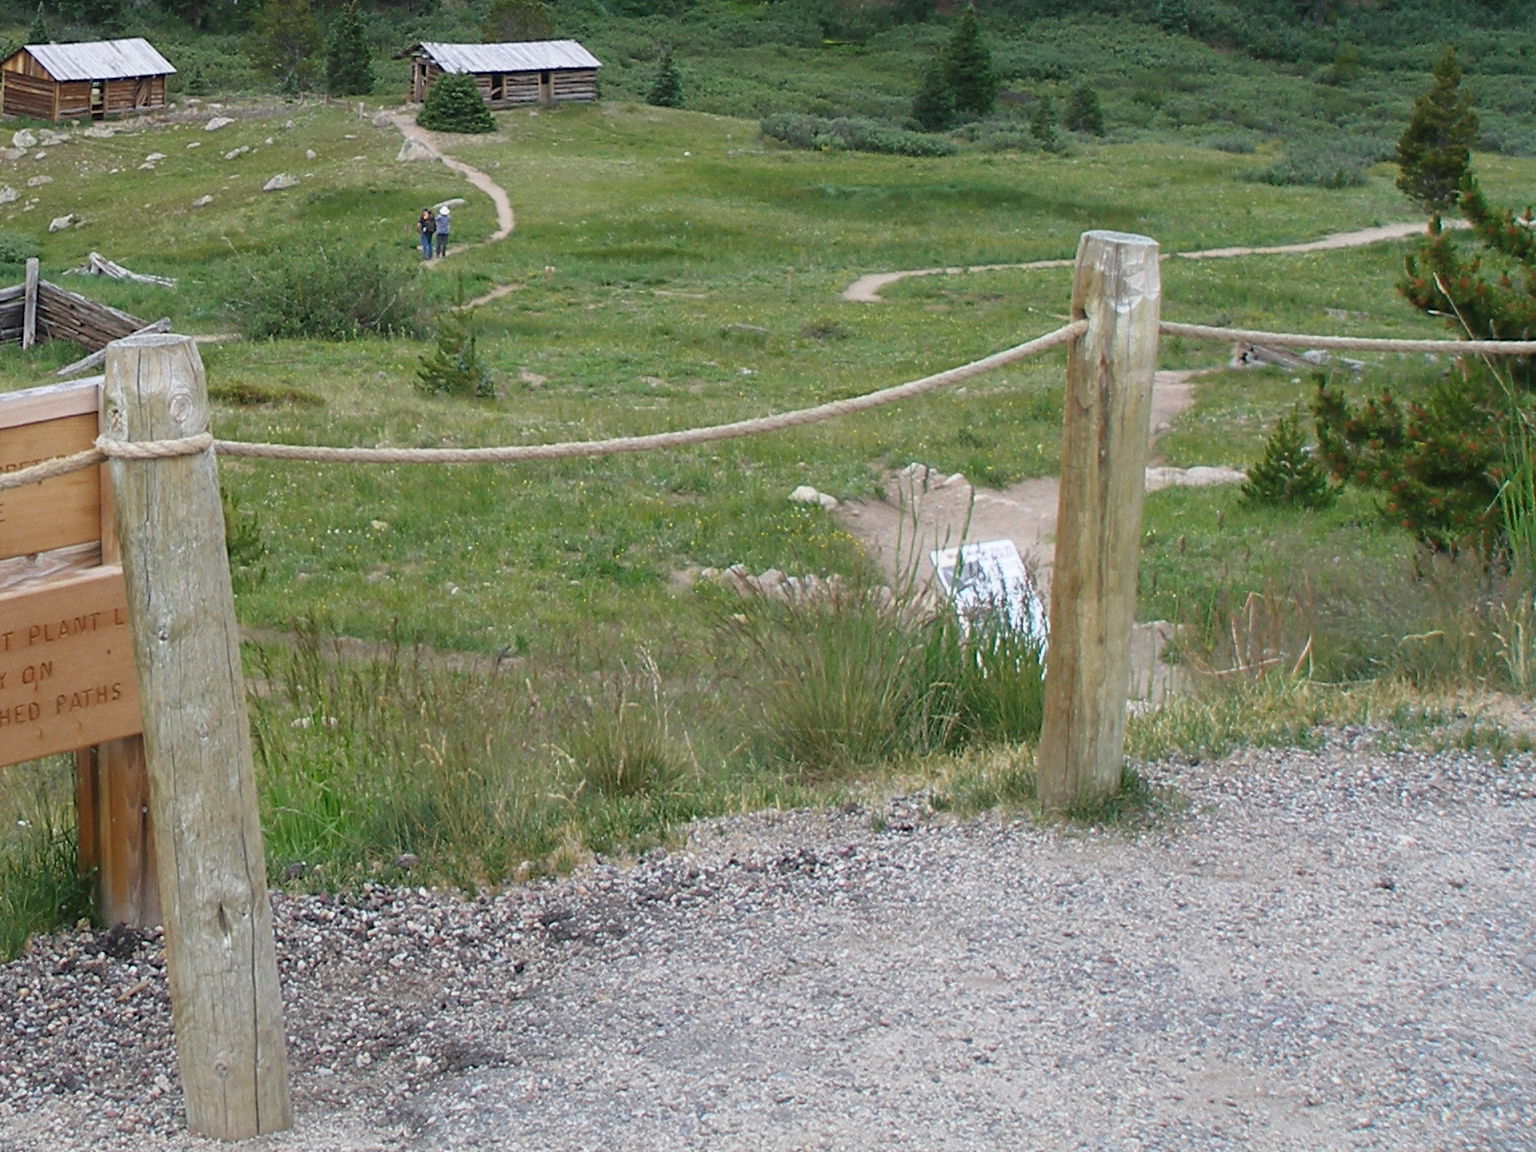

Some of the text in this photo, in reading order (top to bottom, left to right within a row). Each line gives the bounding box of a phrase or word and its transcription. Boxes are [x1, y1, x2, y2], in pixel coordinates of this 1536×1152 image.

[28, 612, 101, 647] PLANT
[21, 660, 54, 685] ON
[55, 682, 122, 715] PATHS
